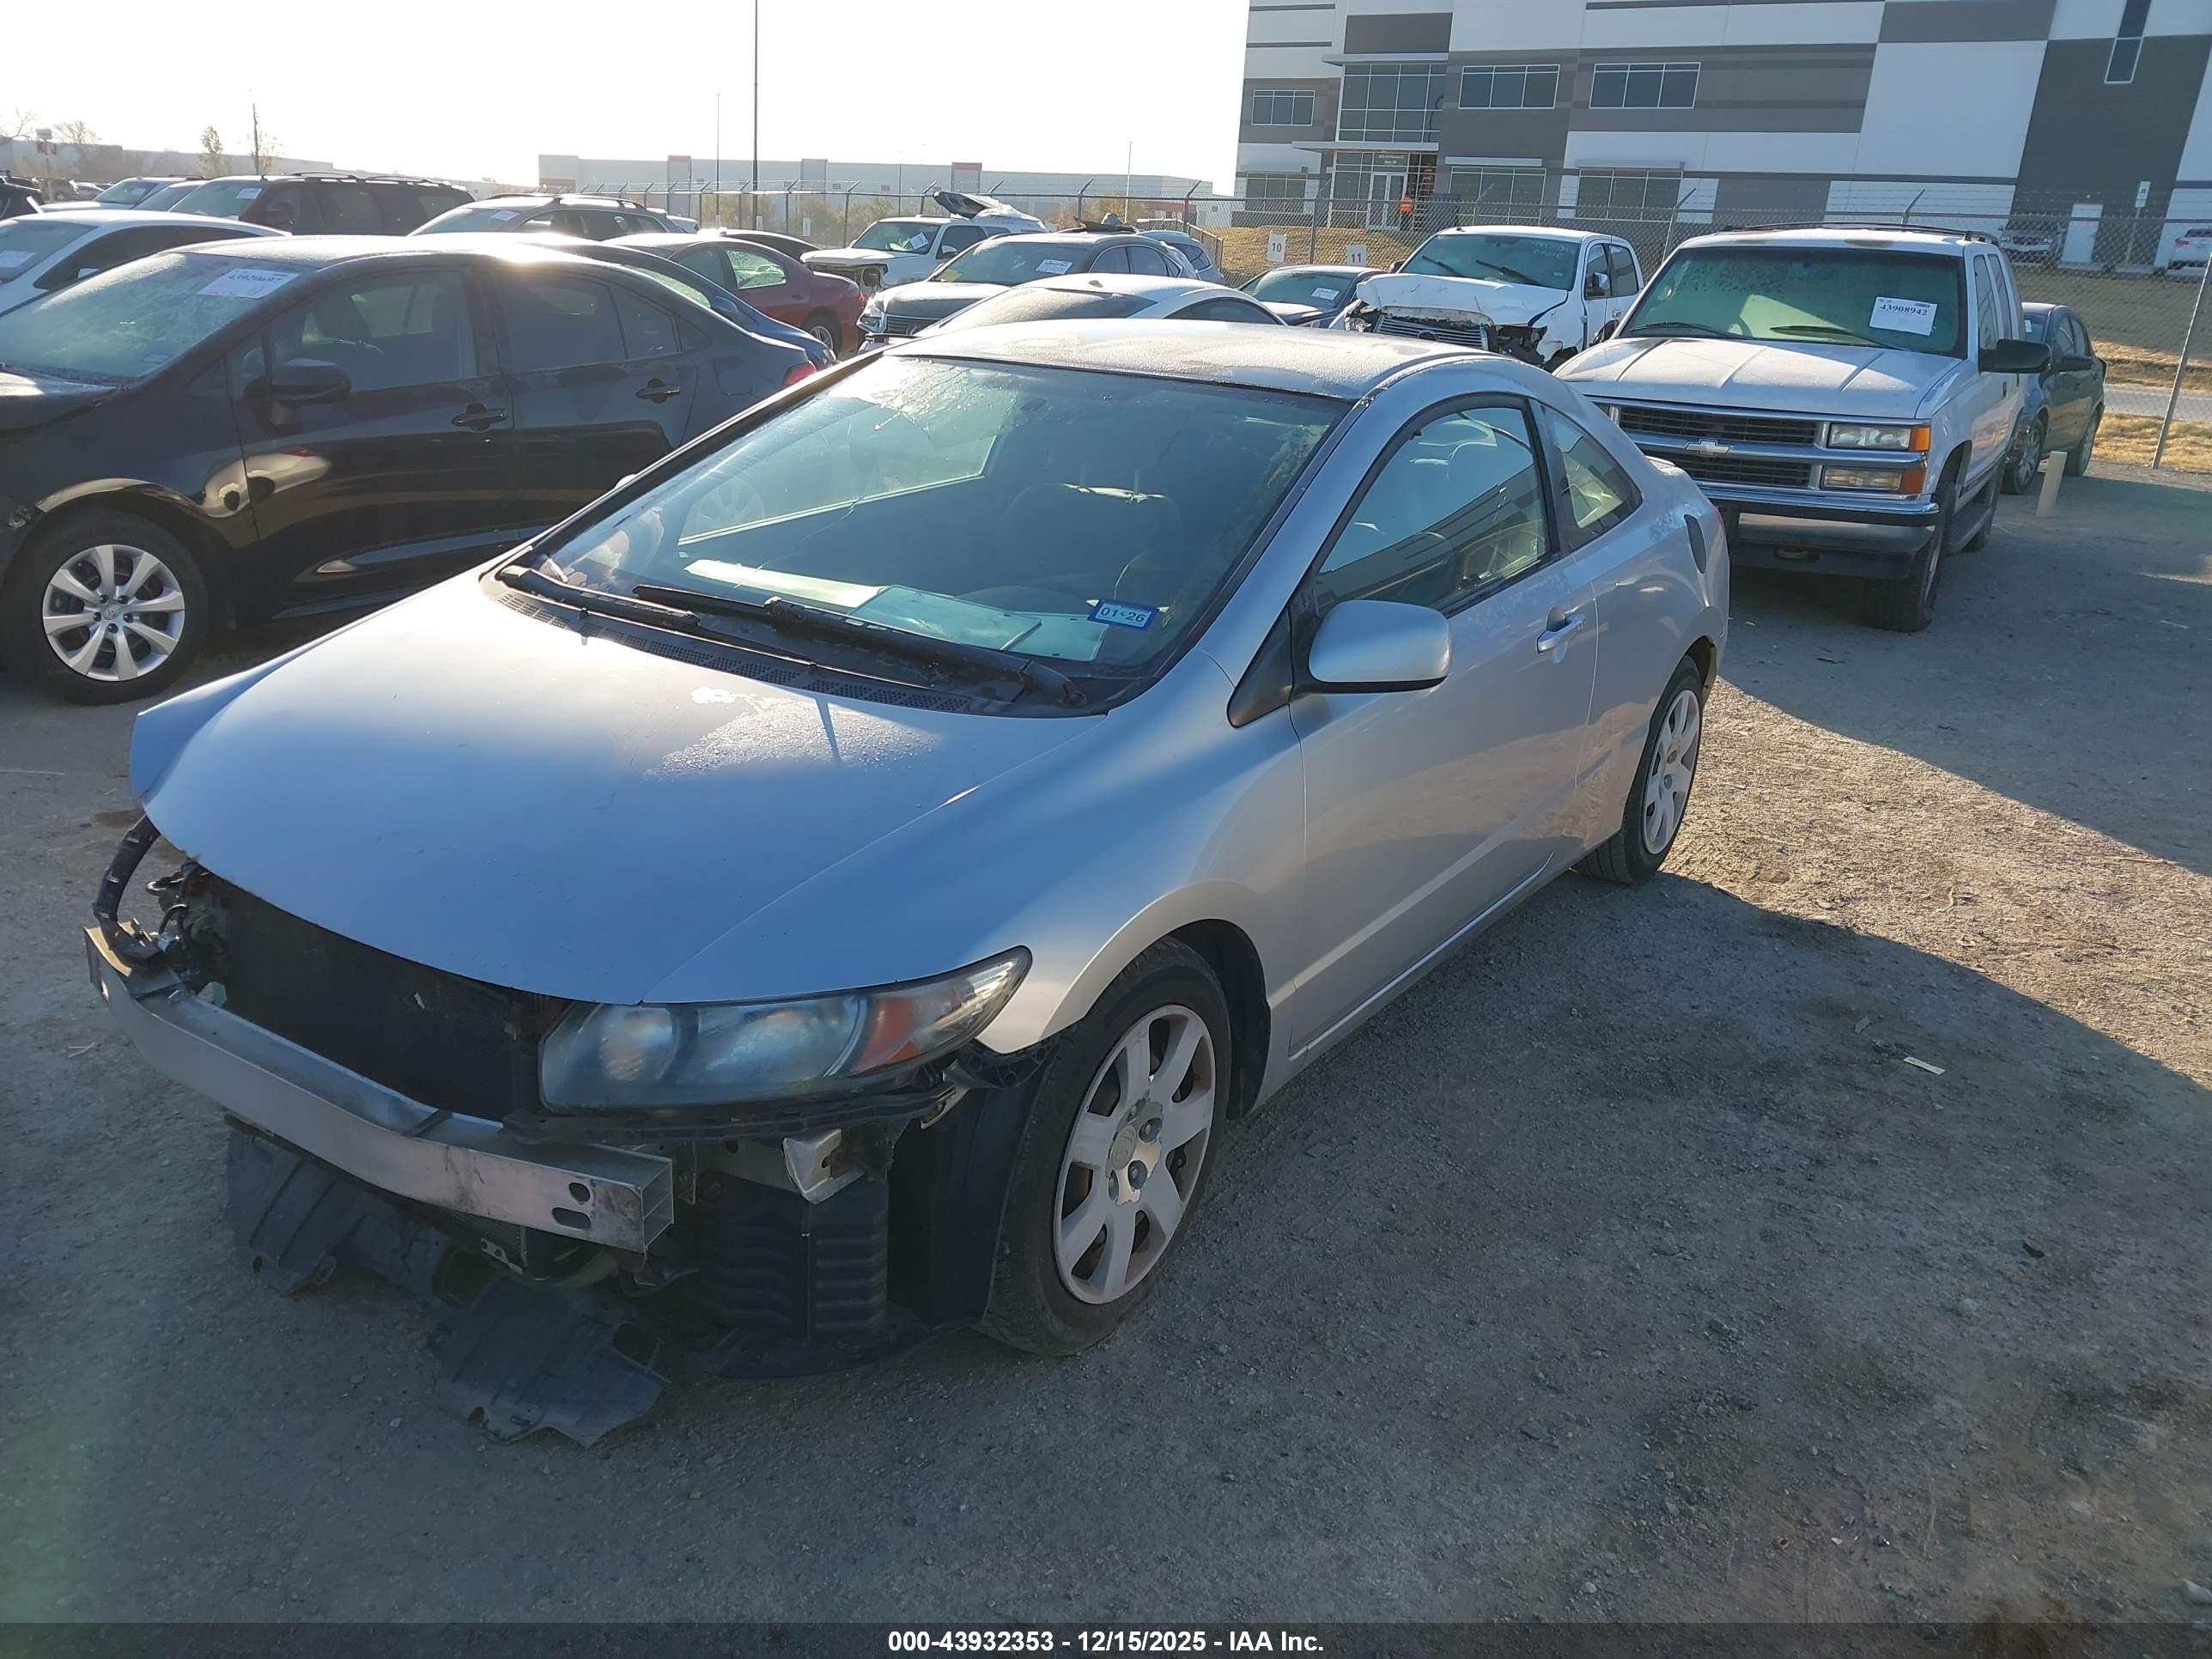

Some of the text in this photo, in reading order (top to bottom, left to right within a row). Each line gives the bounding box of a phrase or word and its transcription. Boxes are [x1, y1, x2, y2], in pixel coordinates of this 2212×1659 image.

[1272, 242, 1282, 252] 10
[1351, 252, 1362, 264] 11
[1881, 303, 1928, 316] 43908942
